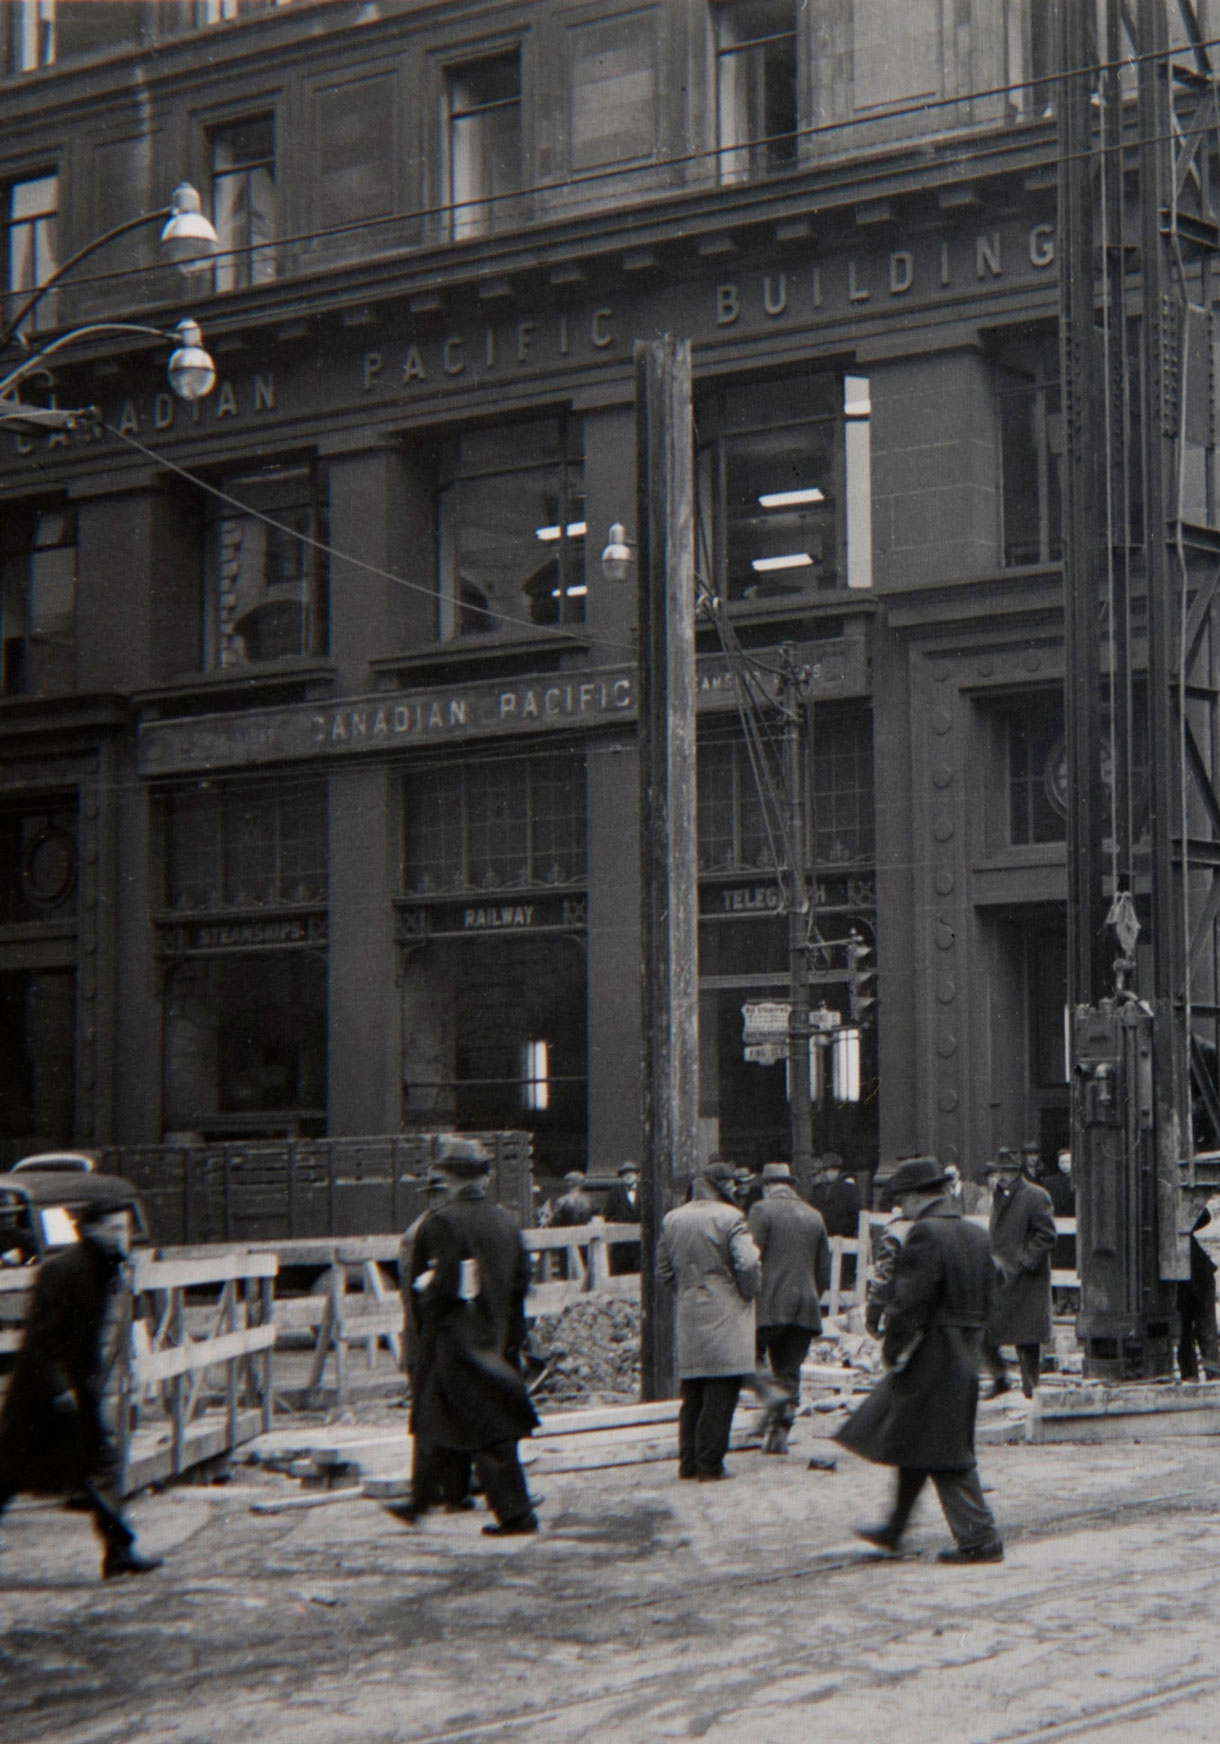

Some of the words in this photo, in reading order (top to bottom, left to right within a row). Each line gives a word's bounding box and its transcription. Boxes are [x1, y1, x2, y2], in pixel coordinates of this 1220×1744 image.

[16, 372, 274, 454] CADIAN
[364, 306, 614, 390] PACIFIC
[716, 225, 1055, 326] BUILDING
[311, 700, 467, 741] CANADIAN
[500, 680, 631, 719] PACIFIC
[464, 904, 535, 928] RAILWAY
[722, 885, 825, 910] TELEGH
